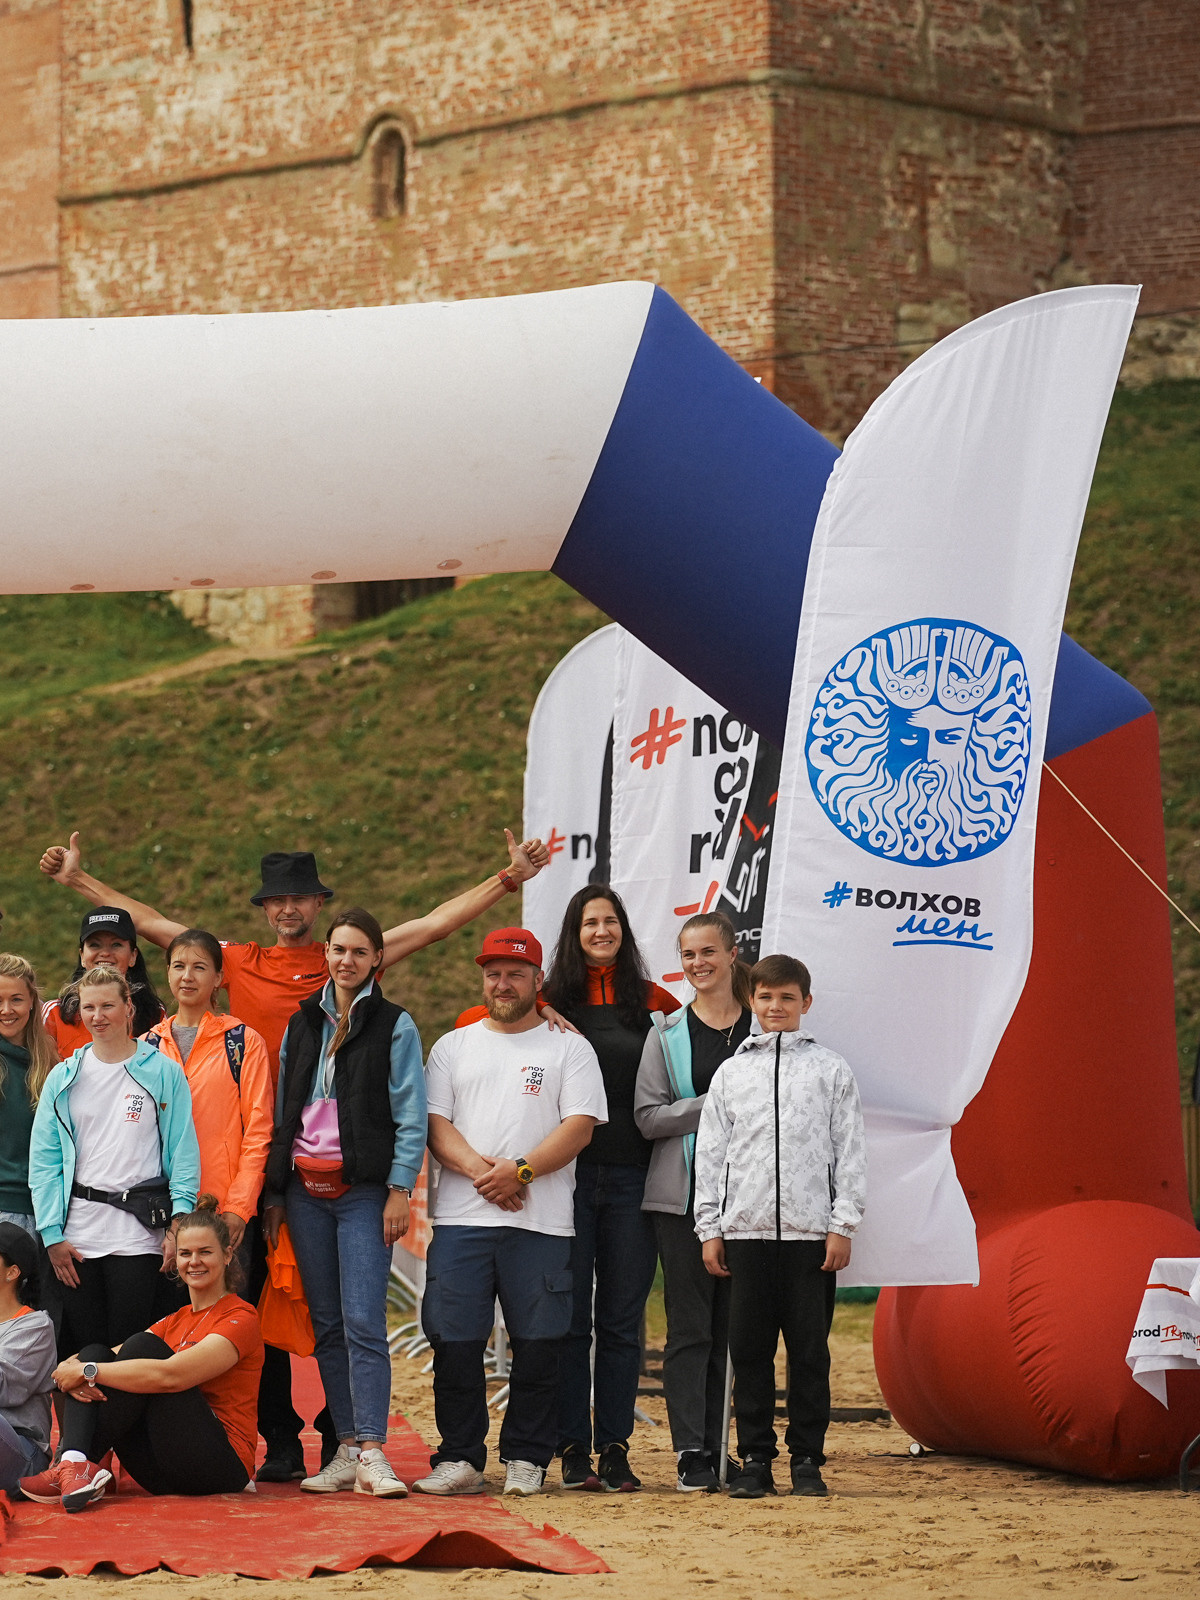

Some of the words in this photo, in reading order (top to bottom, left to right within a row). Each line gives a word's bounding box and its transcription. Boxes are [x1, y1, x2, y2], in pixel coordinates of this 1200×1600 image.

[531, 1071, 543, 1079] go
[526, 1077, 542, 1086] rod
[132, 1099, 143, 1107] go
[128, 1105, 142, 1113] rod
